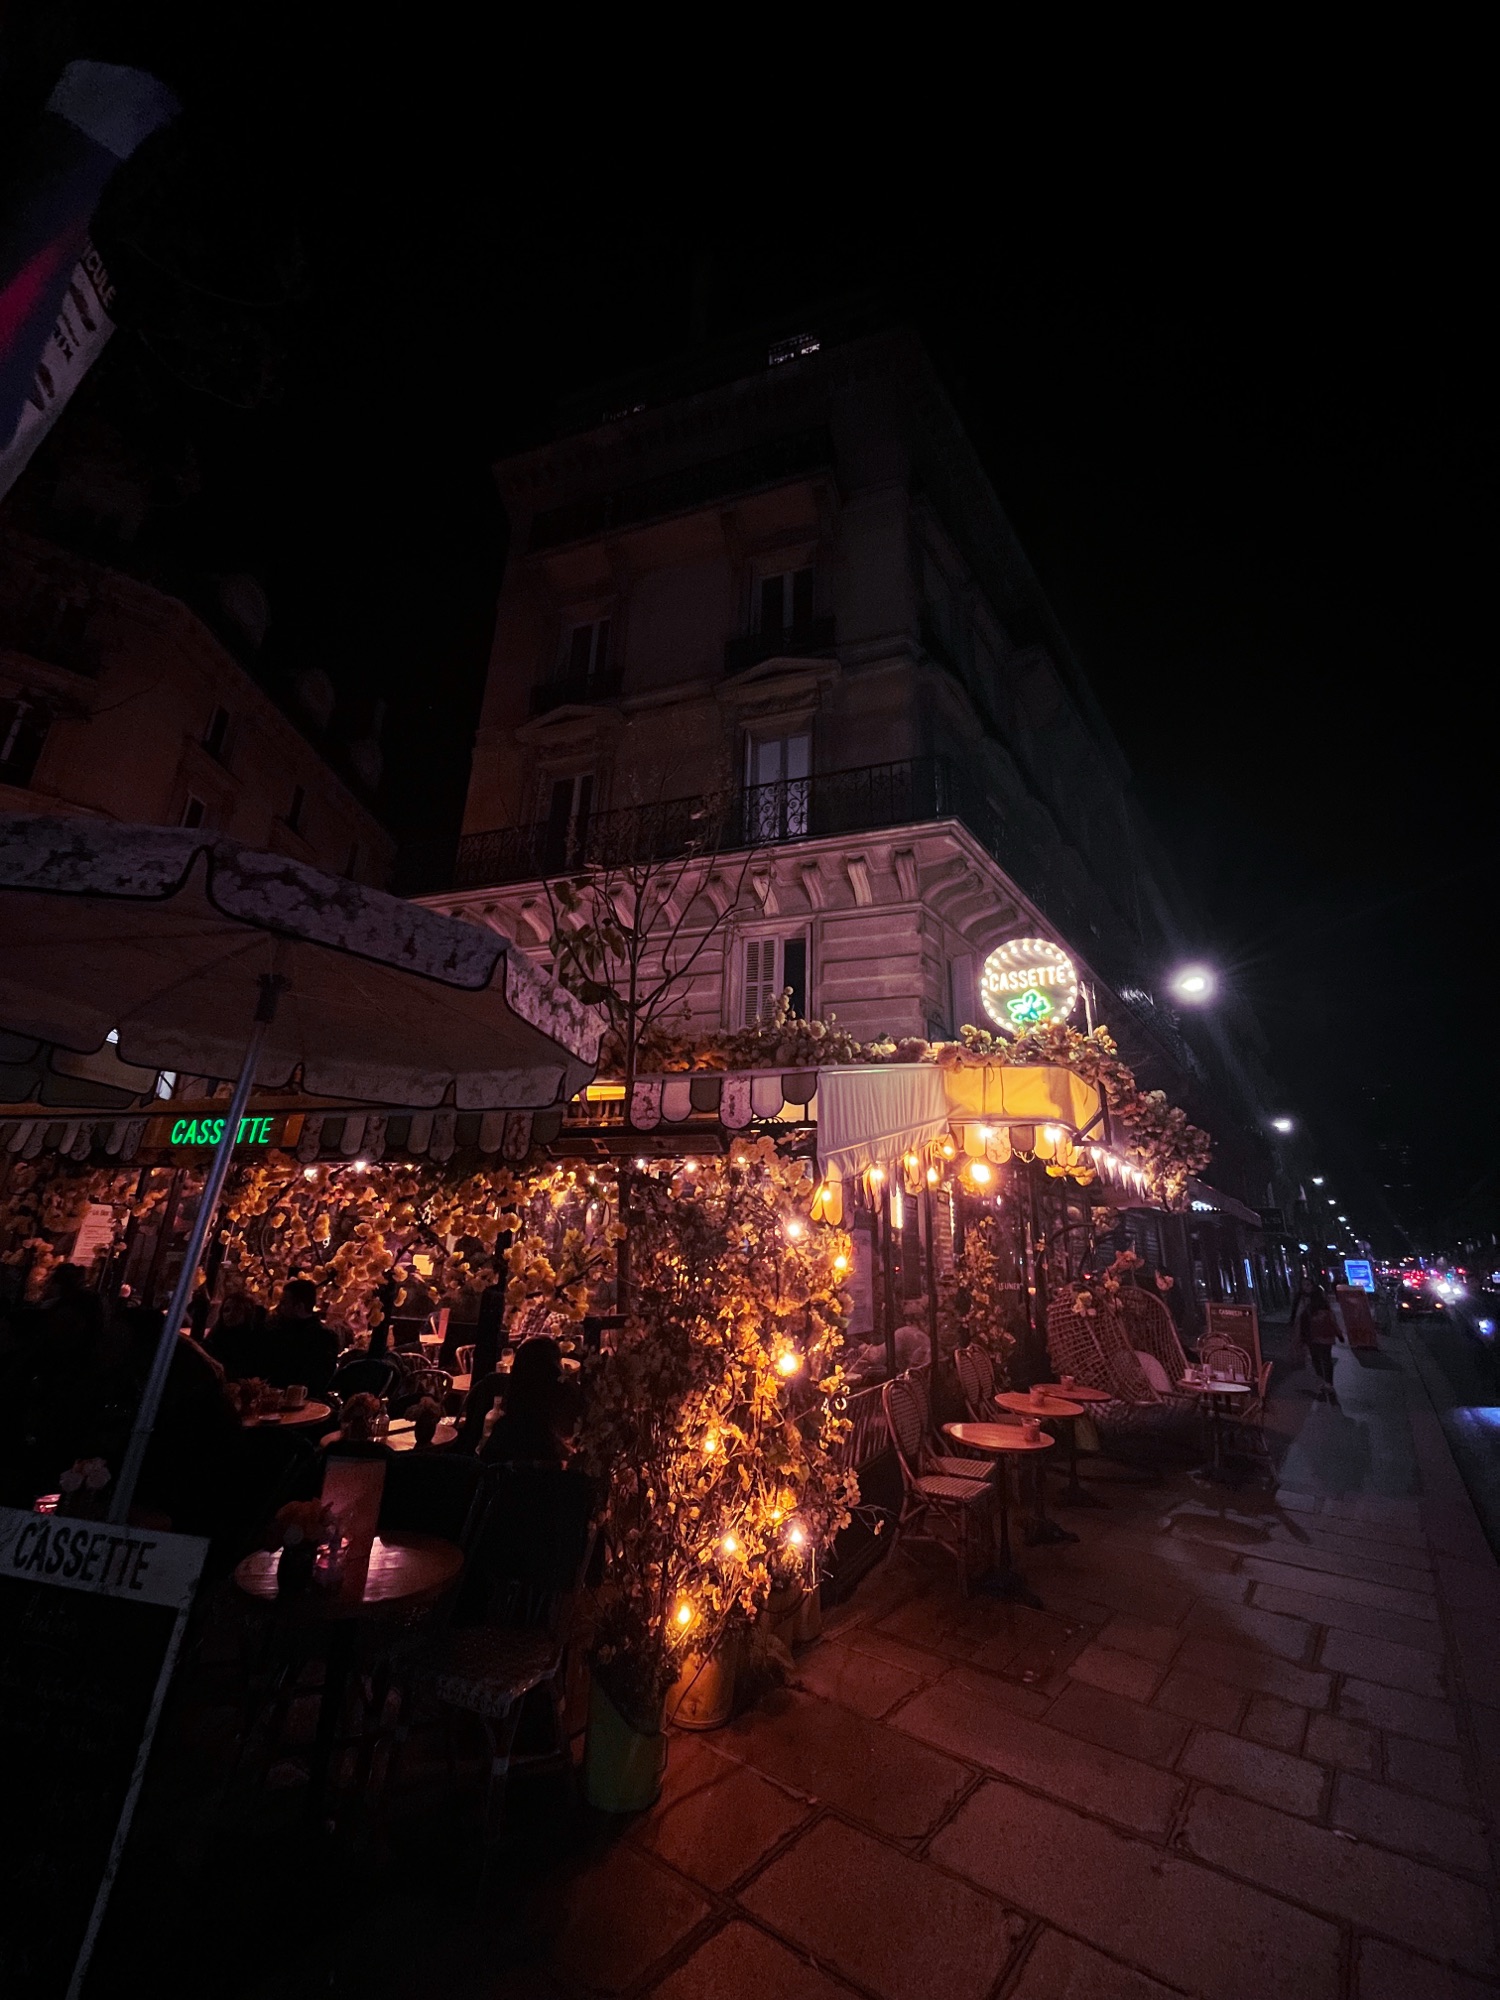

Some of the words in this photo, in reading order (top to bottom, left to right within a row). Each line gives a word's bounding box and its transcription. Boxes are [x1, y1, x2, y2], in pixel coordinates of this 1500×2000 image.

[989, 964, 1067, 992] CASSETTE
[170, 1116, 275, 1145] CASSTTE
[13, 1521, 156, 1590] CASSETTE
